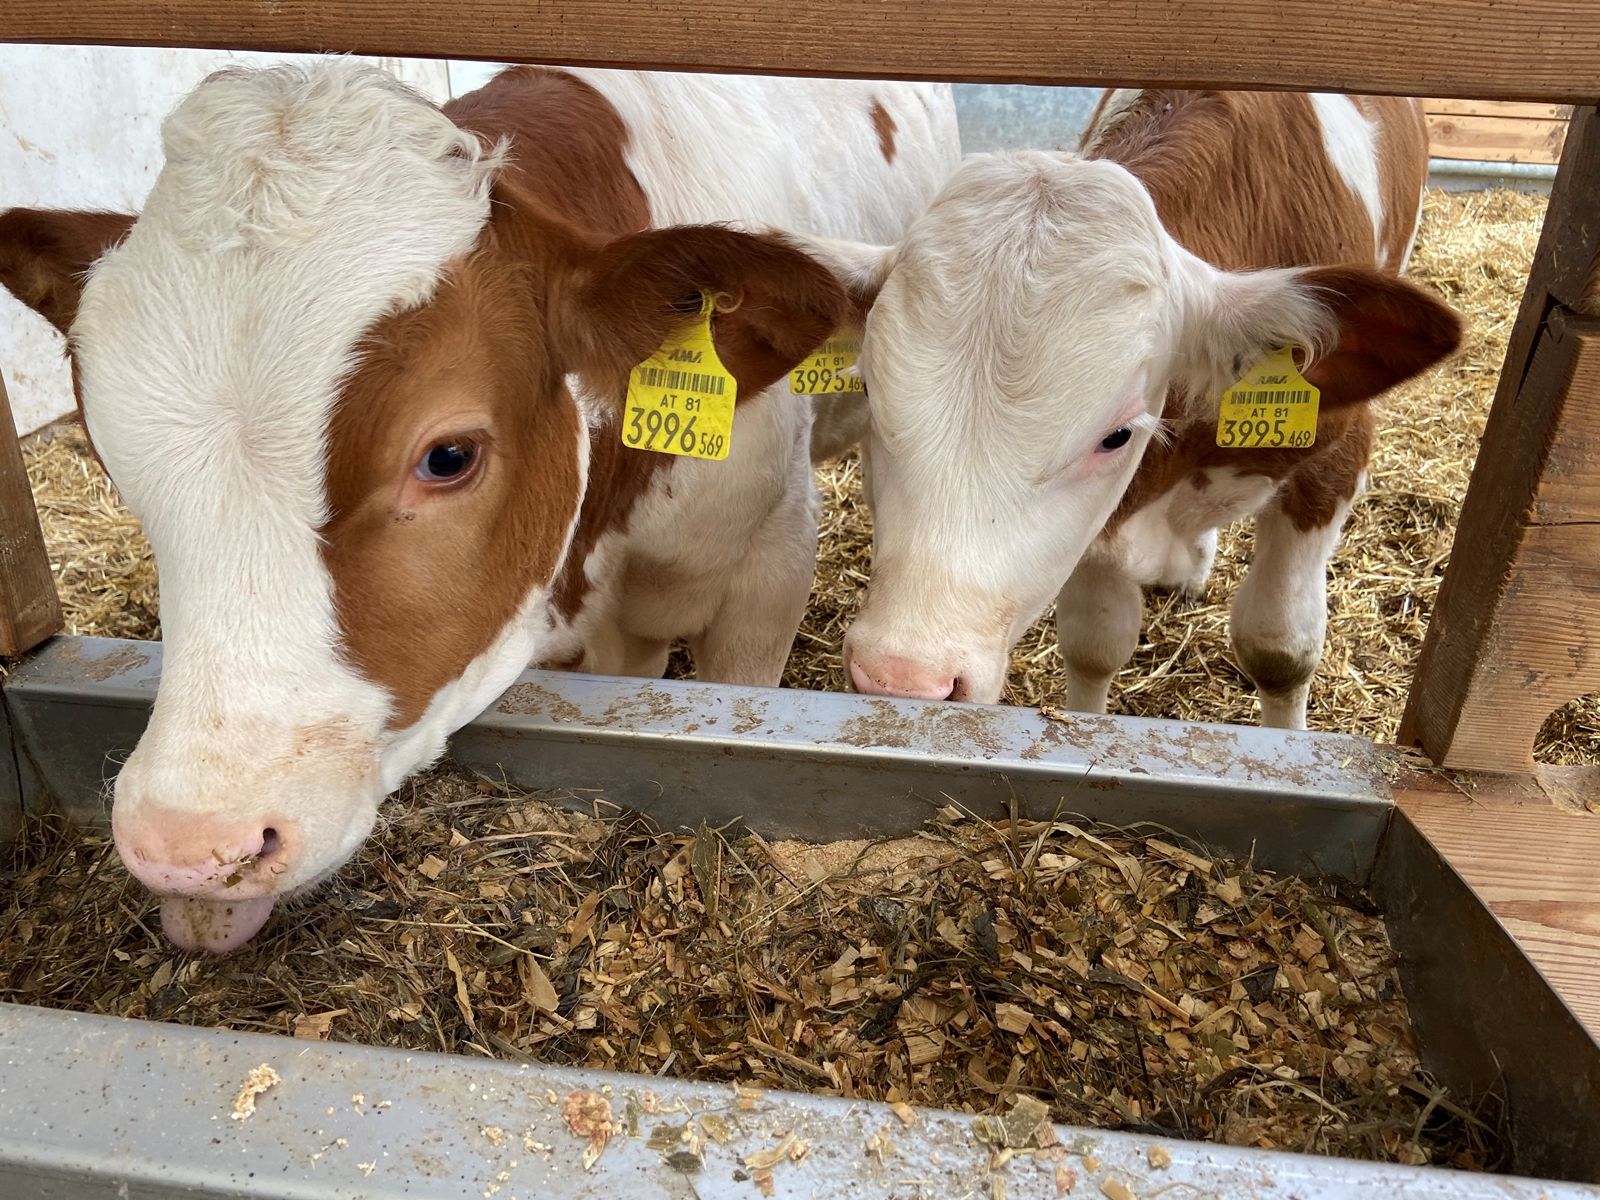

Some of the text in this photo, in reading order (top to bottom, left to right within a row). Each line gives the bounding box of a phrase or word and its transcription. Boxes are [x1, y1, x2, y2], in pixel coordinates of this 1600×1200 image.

[815, 356, 845, 367] AT 81
[794, 367, 846, 394] 3995
[660, 394, 701, 412] AT 81
[1250, 407, 1289, 418] AT 81
[626, 407, 724, 457] 3996 569
[1221, 419, 1311, 447] 3995 469
